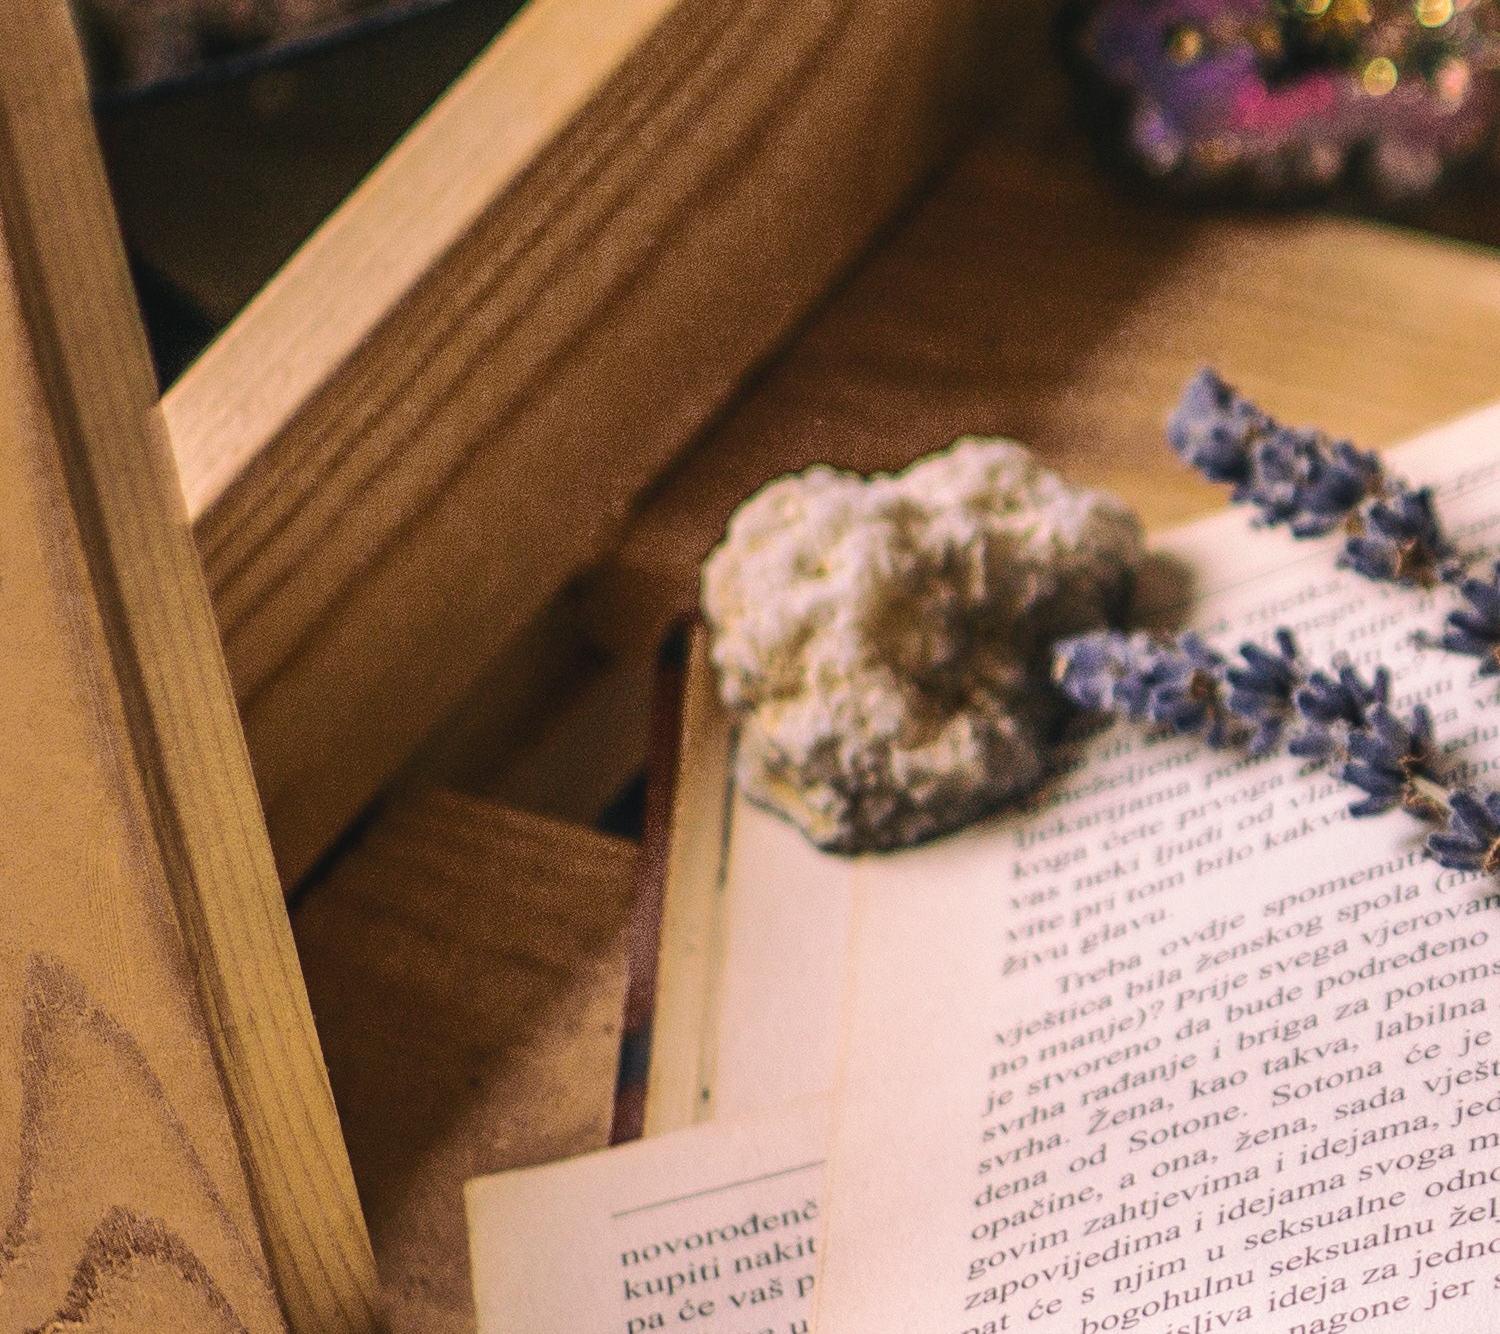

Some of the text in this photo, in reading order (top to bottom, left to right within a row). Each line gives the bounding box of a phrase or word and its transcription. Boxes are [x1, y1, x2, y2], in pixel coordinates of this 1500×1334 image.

[993, 882, 1421, 1047] vještica ženskog spola
[1028, 935, 1488, 1096] stvoreno bude podređeno
[1037, 938, 1349, 1062] manje)? Prije svega
[1055, 913, 1245, 998] Treba ovdje
[977, 991, 1488, 1177] svrha. Žena, takva, labilna
[1080, 1012, 1319, 1107] rađanje briga
[1128, 1059, 1384, 1154] Sotone. Sotona
[970, 1182, 1104, 1245] opačine,
[1334, 1083, 1407, 1121] sada
[1082, 1161, 1261, 1237] zahtjevima
[1298, 1111, 1439, 1170] idejama,
[1244, 1186, 1406, 1249] seksualne
[623, 1237, 816, 1301] kupiti nakit
[963, 1223, 1182, 1313] zapovijedima
[1359, 1142, 1456, 1182] svoga
[729, 1279, 783, 1309] vaš
